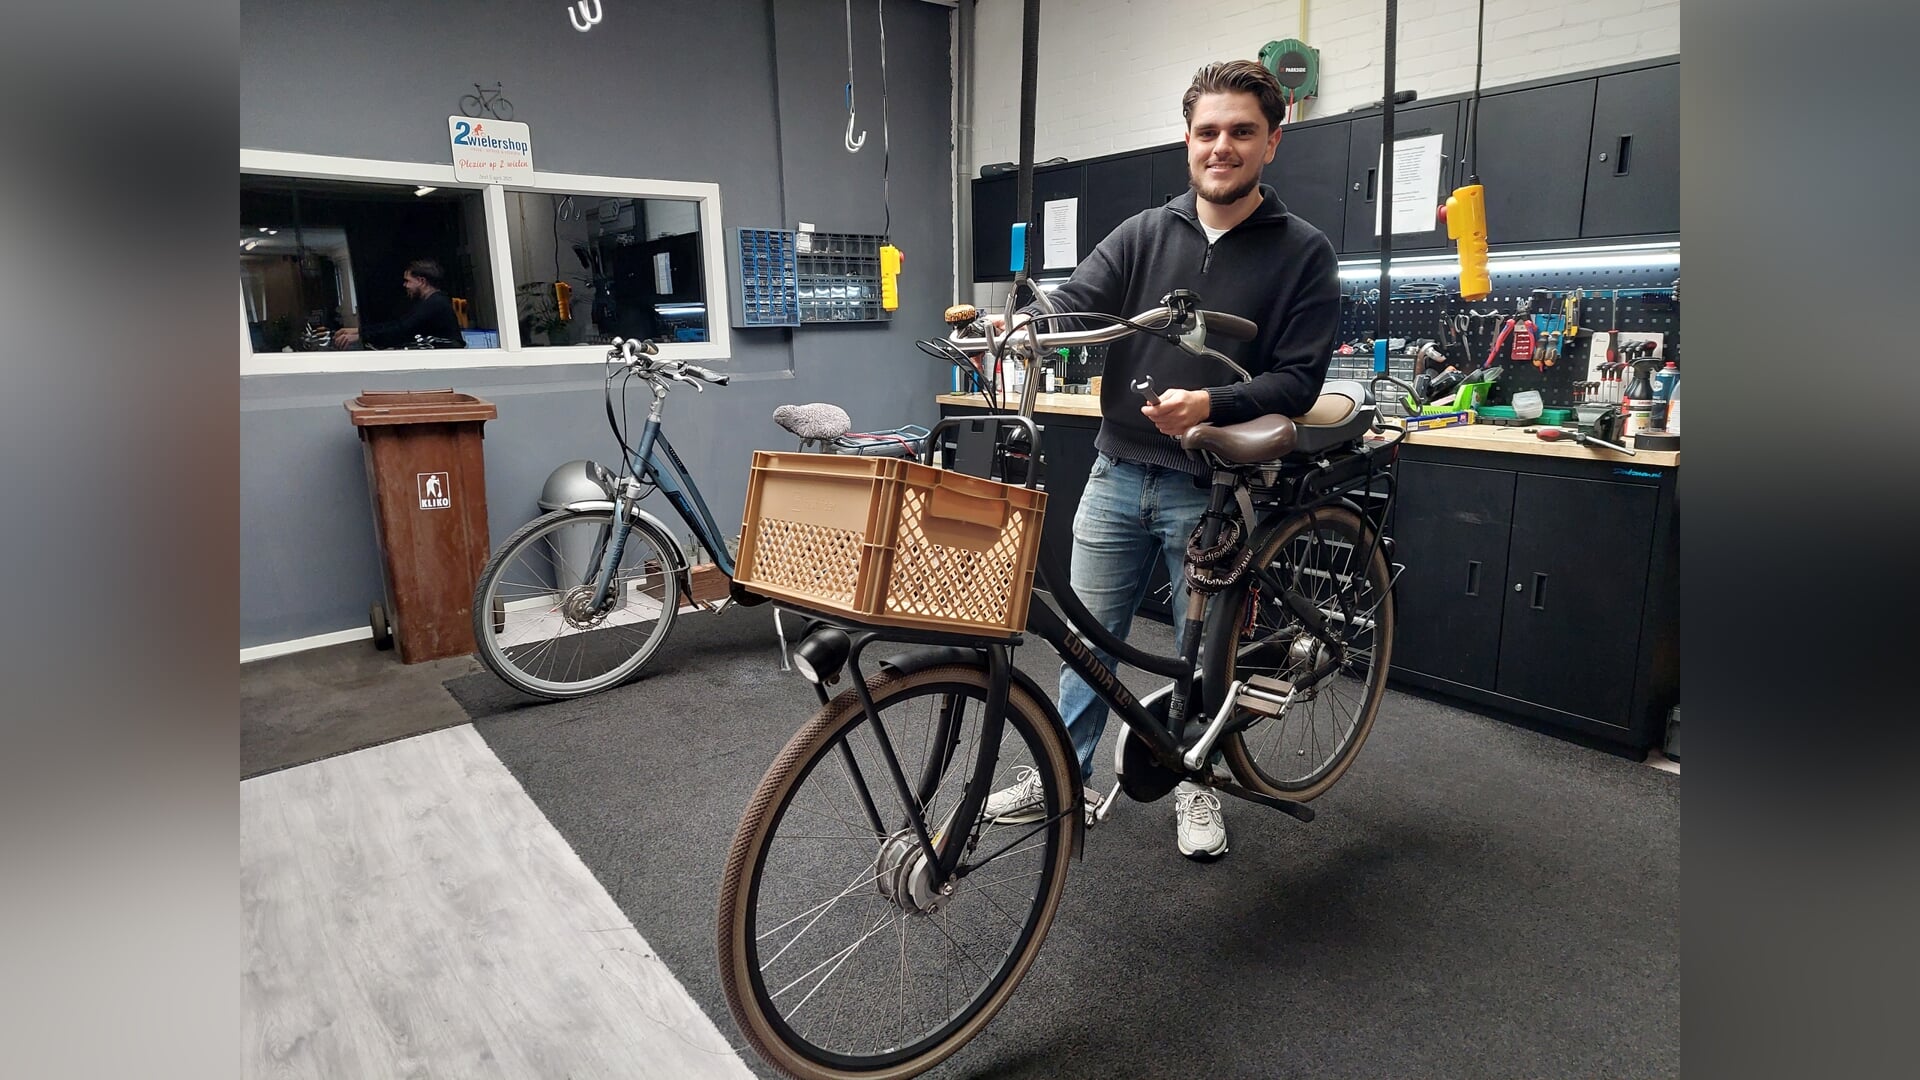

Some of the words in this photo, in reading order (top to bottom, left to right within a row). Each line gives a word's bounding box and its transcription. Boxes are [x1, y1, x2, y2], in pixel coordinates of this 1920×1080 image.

[454, 122, 528, 155] 2wielershop
[459, 159, 486, 168] Plezier
[489, 162, 497, 170] op
[499, 160, 504, 168] 2
[421, 498, 448, 507] KLIKO
[1063, 631, 1115, 690] CORTINA
